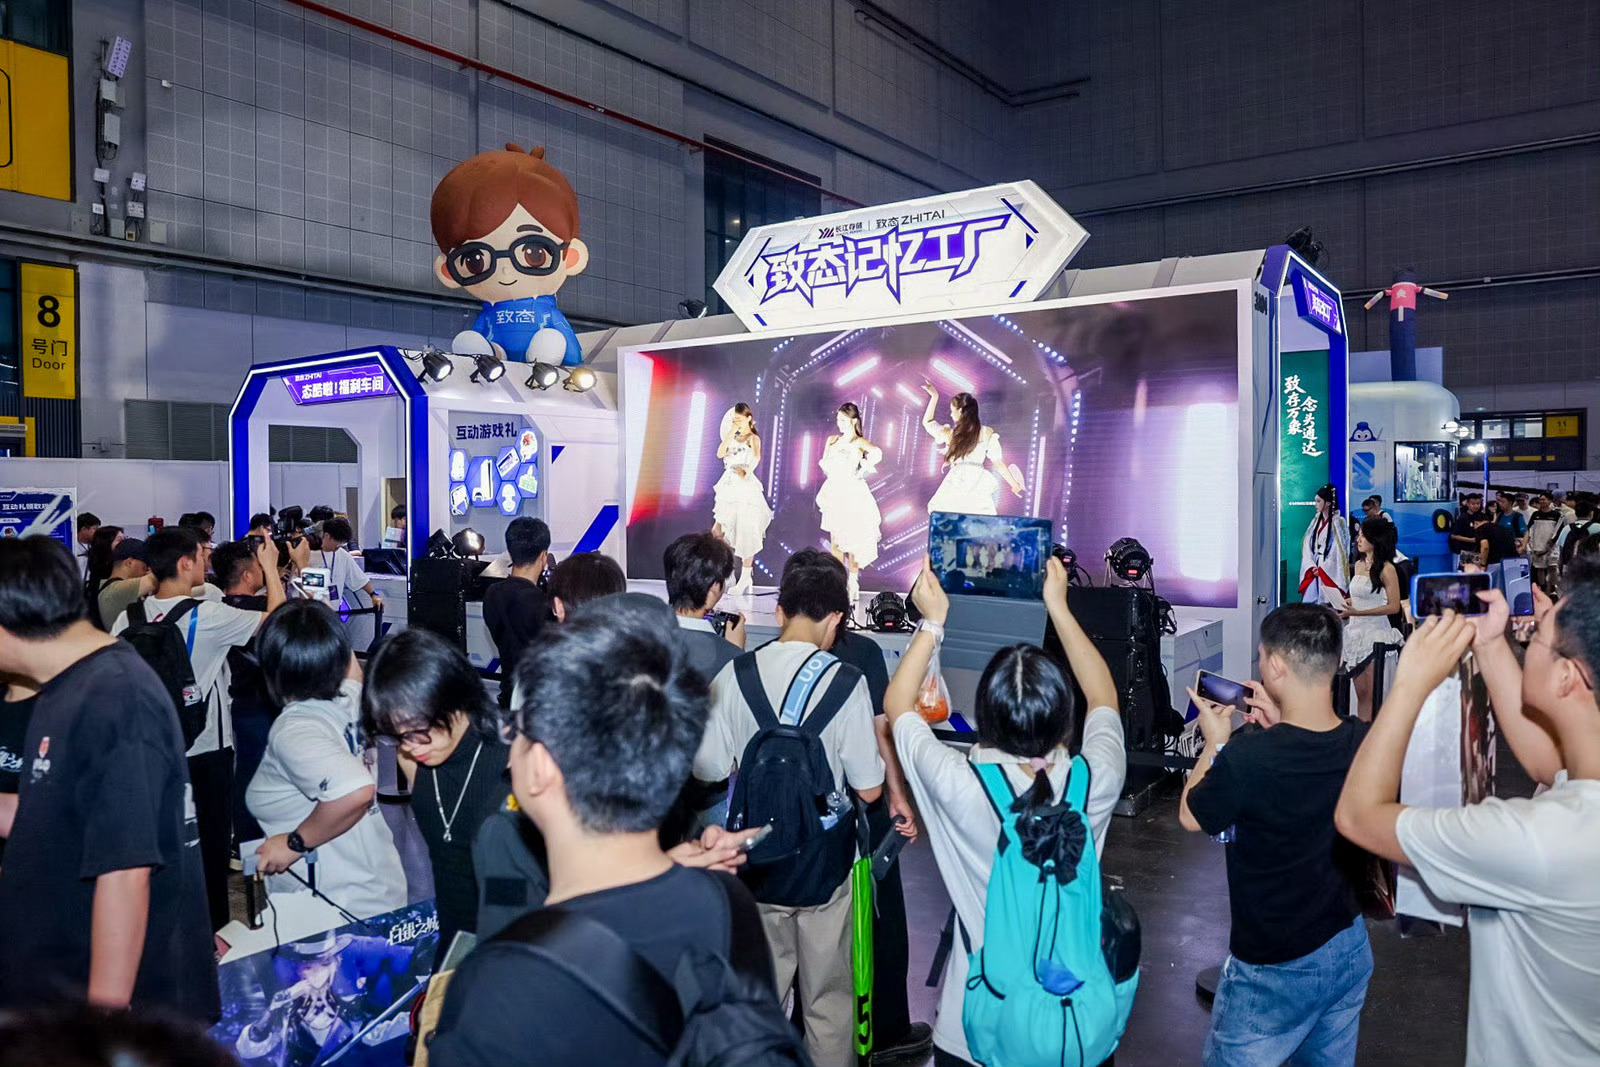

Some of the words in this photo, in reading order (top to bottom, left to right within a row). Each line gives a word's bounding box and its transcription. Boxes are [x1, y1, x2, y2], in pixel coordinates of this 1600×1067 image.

[835, 221, 863, 232] 长江存储
[875, 217, 898, 230] 致态
[901, 209, 945, 225] ZHITAI
[758, 213, 1012, 307] 致态记忆工厂
[37, 294, 61, 328] 8
[495, 309, 535, 324] 致态
[32, 338, 68, 357] 号门
[32, 357, 66, 371] Door
[456, 421, 518, 441] 互动游戏礼
